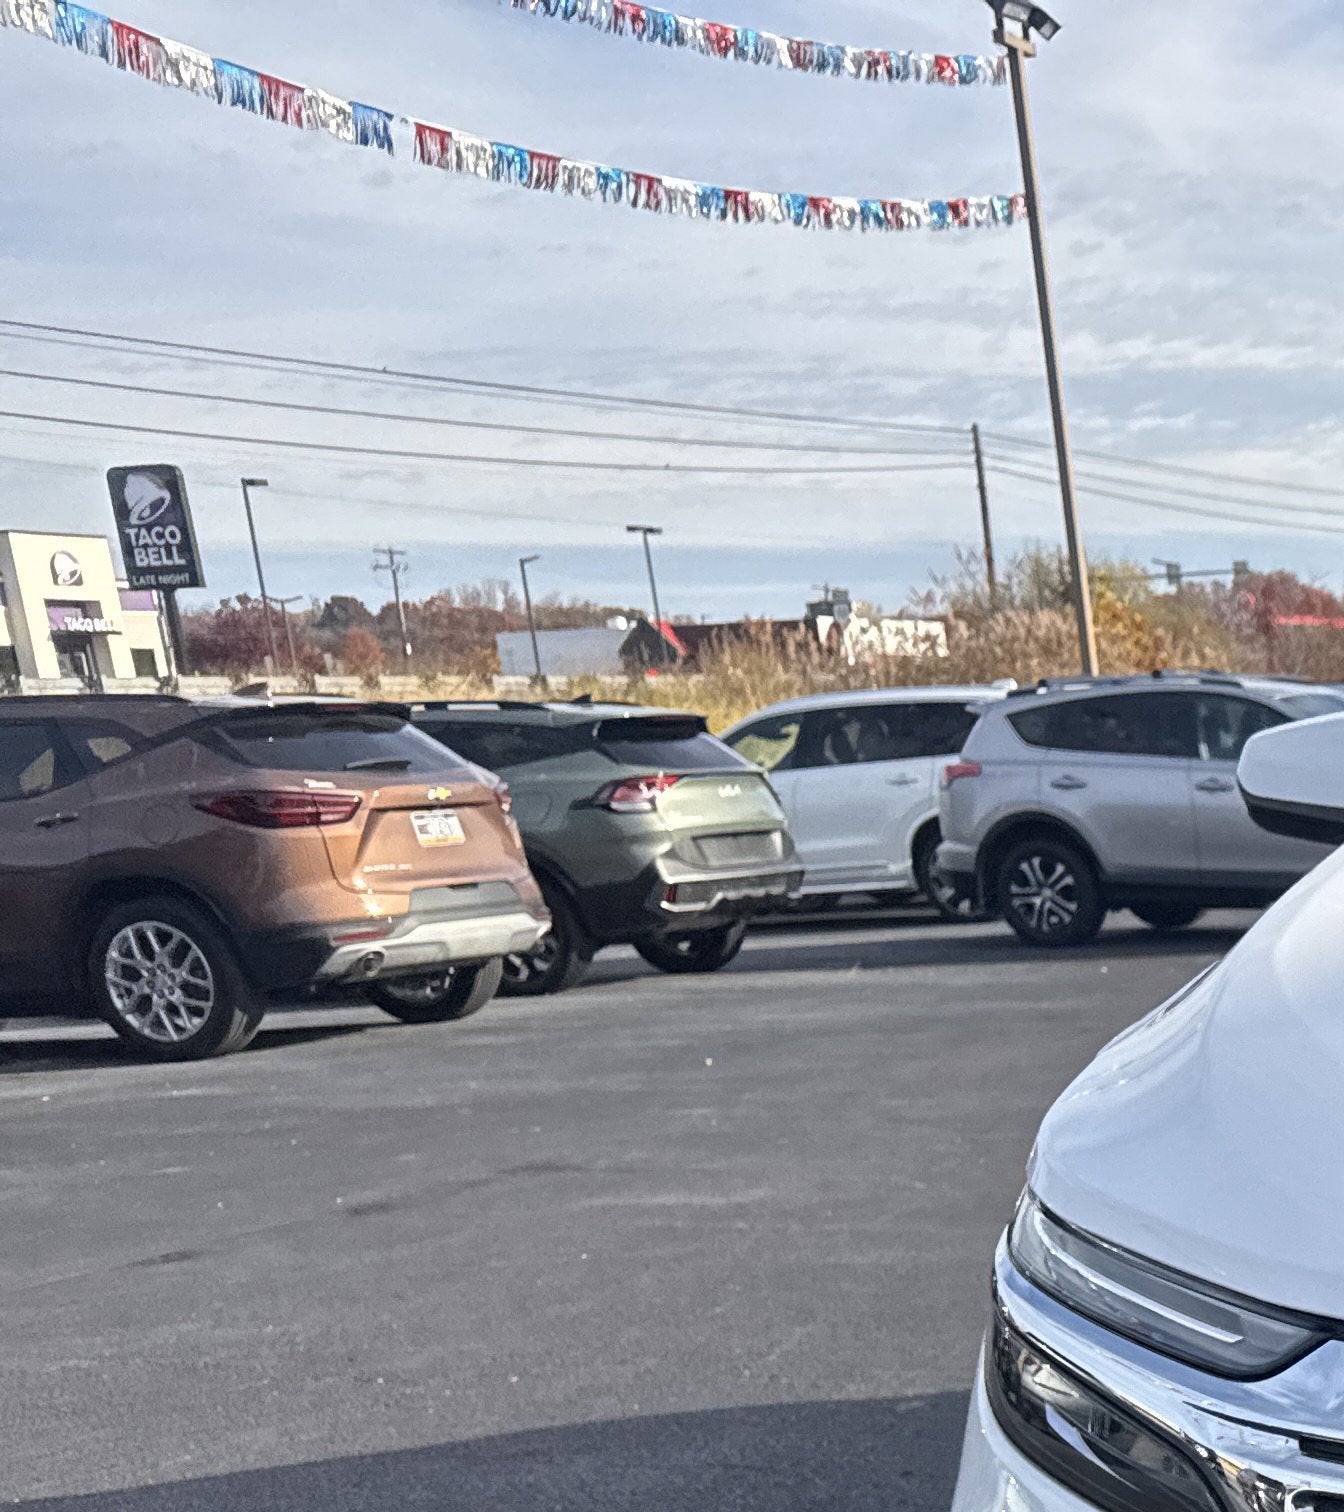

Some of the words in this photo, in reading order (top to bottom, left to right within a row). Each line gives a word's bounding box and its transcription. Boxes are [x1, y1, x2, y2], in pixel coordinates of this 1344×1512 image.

[124, 525, 182, 546] TACO
[133, 544, 187, 567] BELL
[132, 574, 157, 585] LATE
[158, 572, 190, 584] NIGHT
[64, 615, 94, 632] TACO
